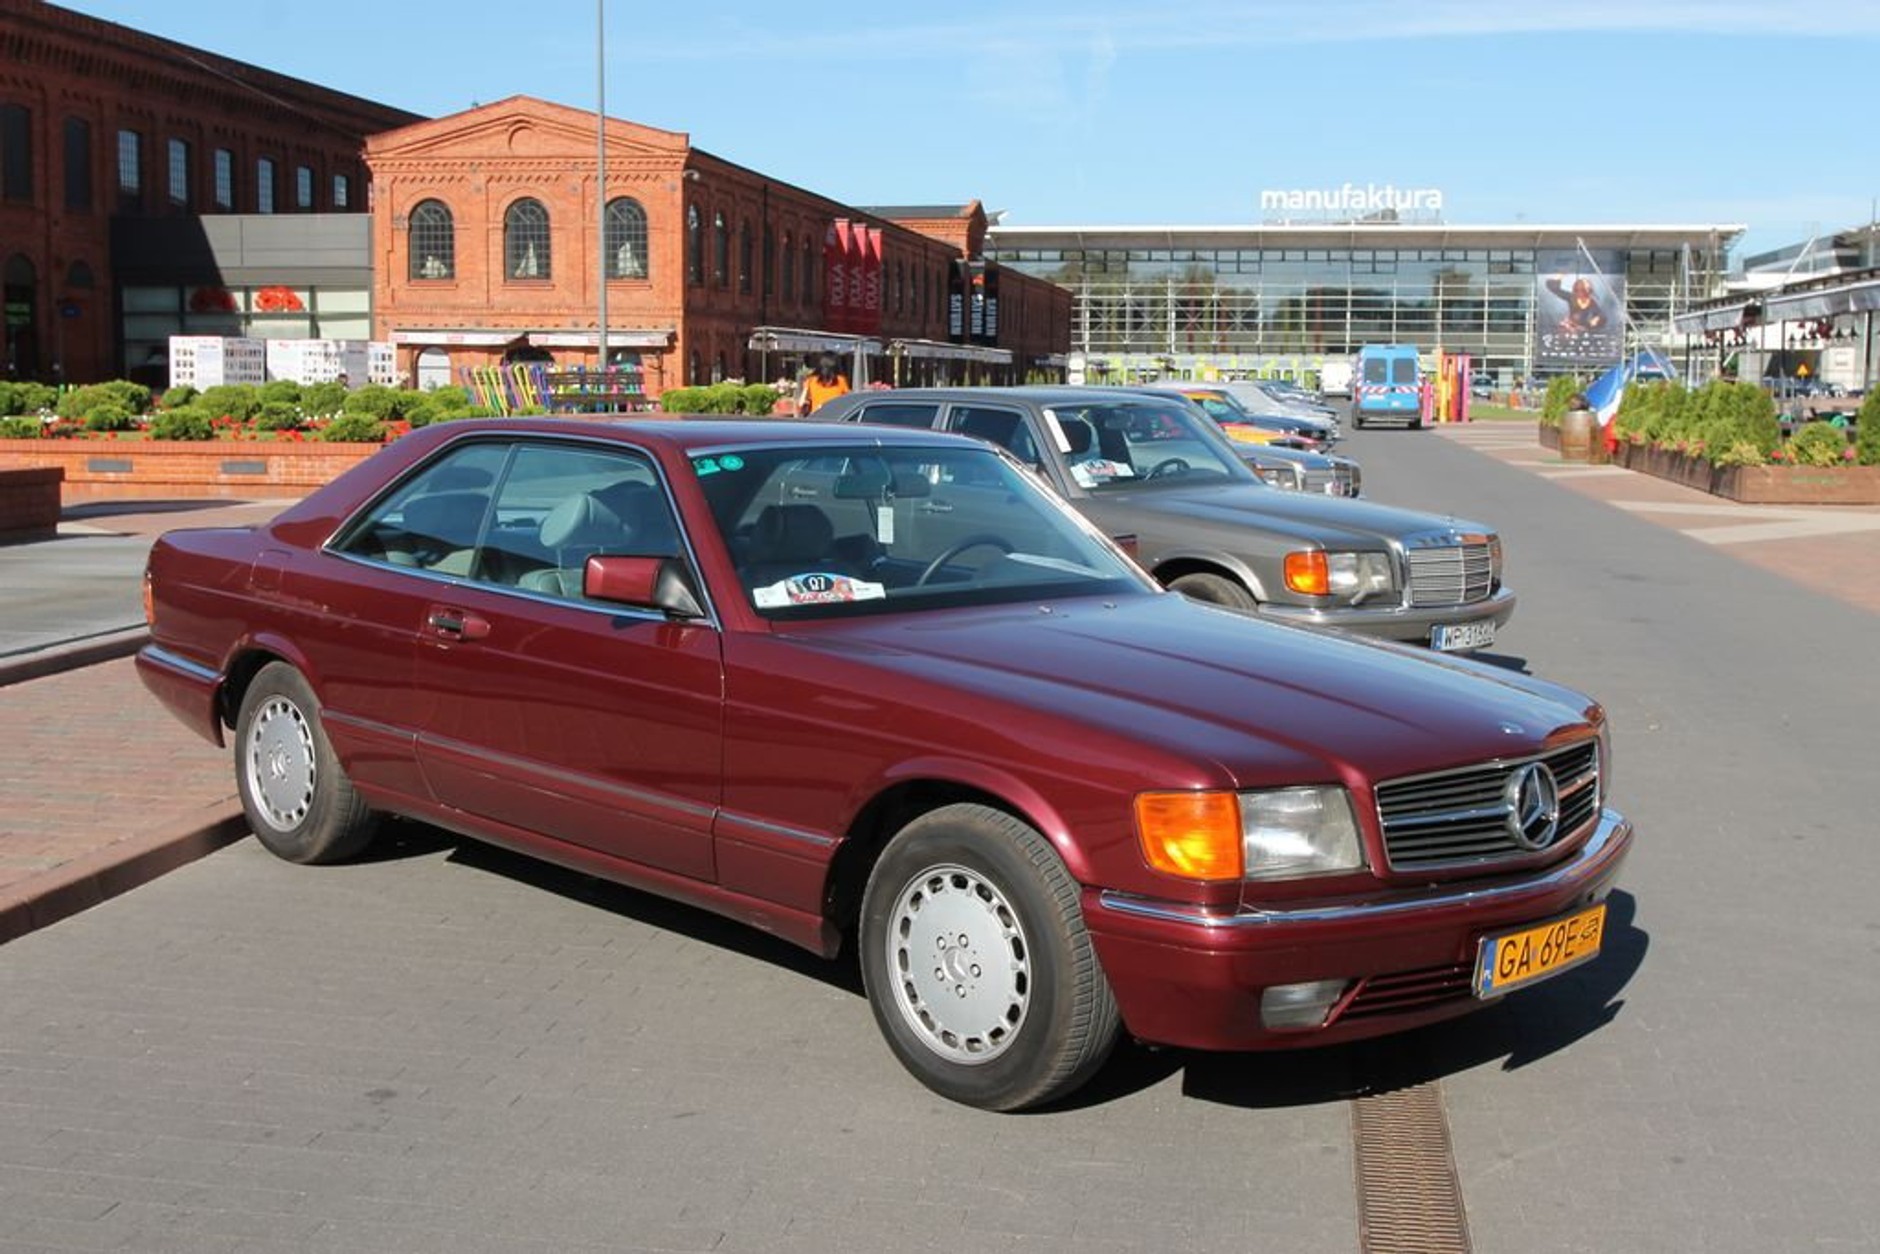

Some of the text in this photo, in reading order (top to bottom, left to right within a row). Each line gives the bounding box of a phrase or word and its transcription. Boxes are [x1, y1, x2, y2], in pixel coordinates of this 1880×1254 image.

[1260, 183, 1443, 210] manufaktura
[1499, 918, 1579, 979] GA 69E
